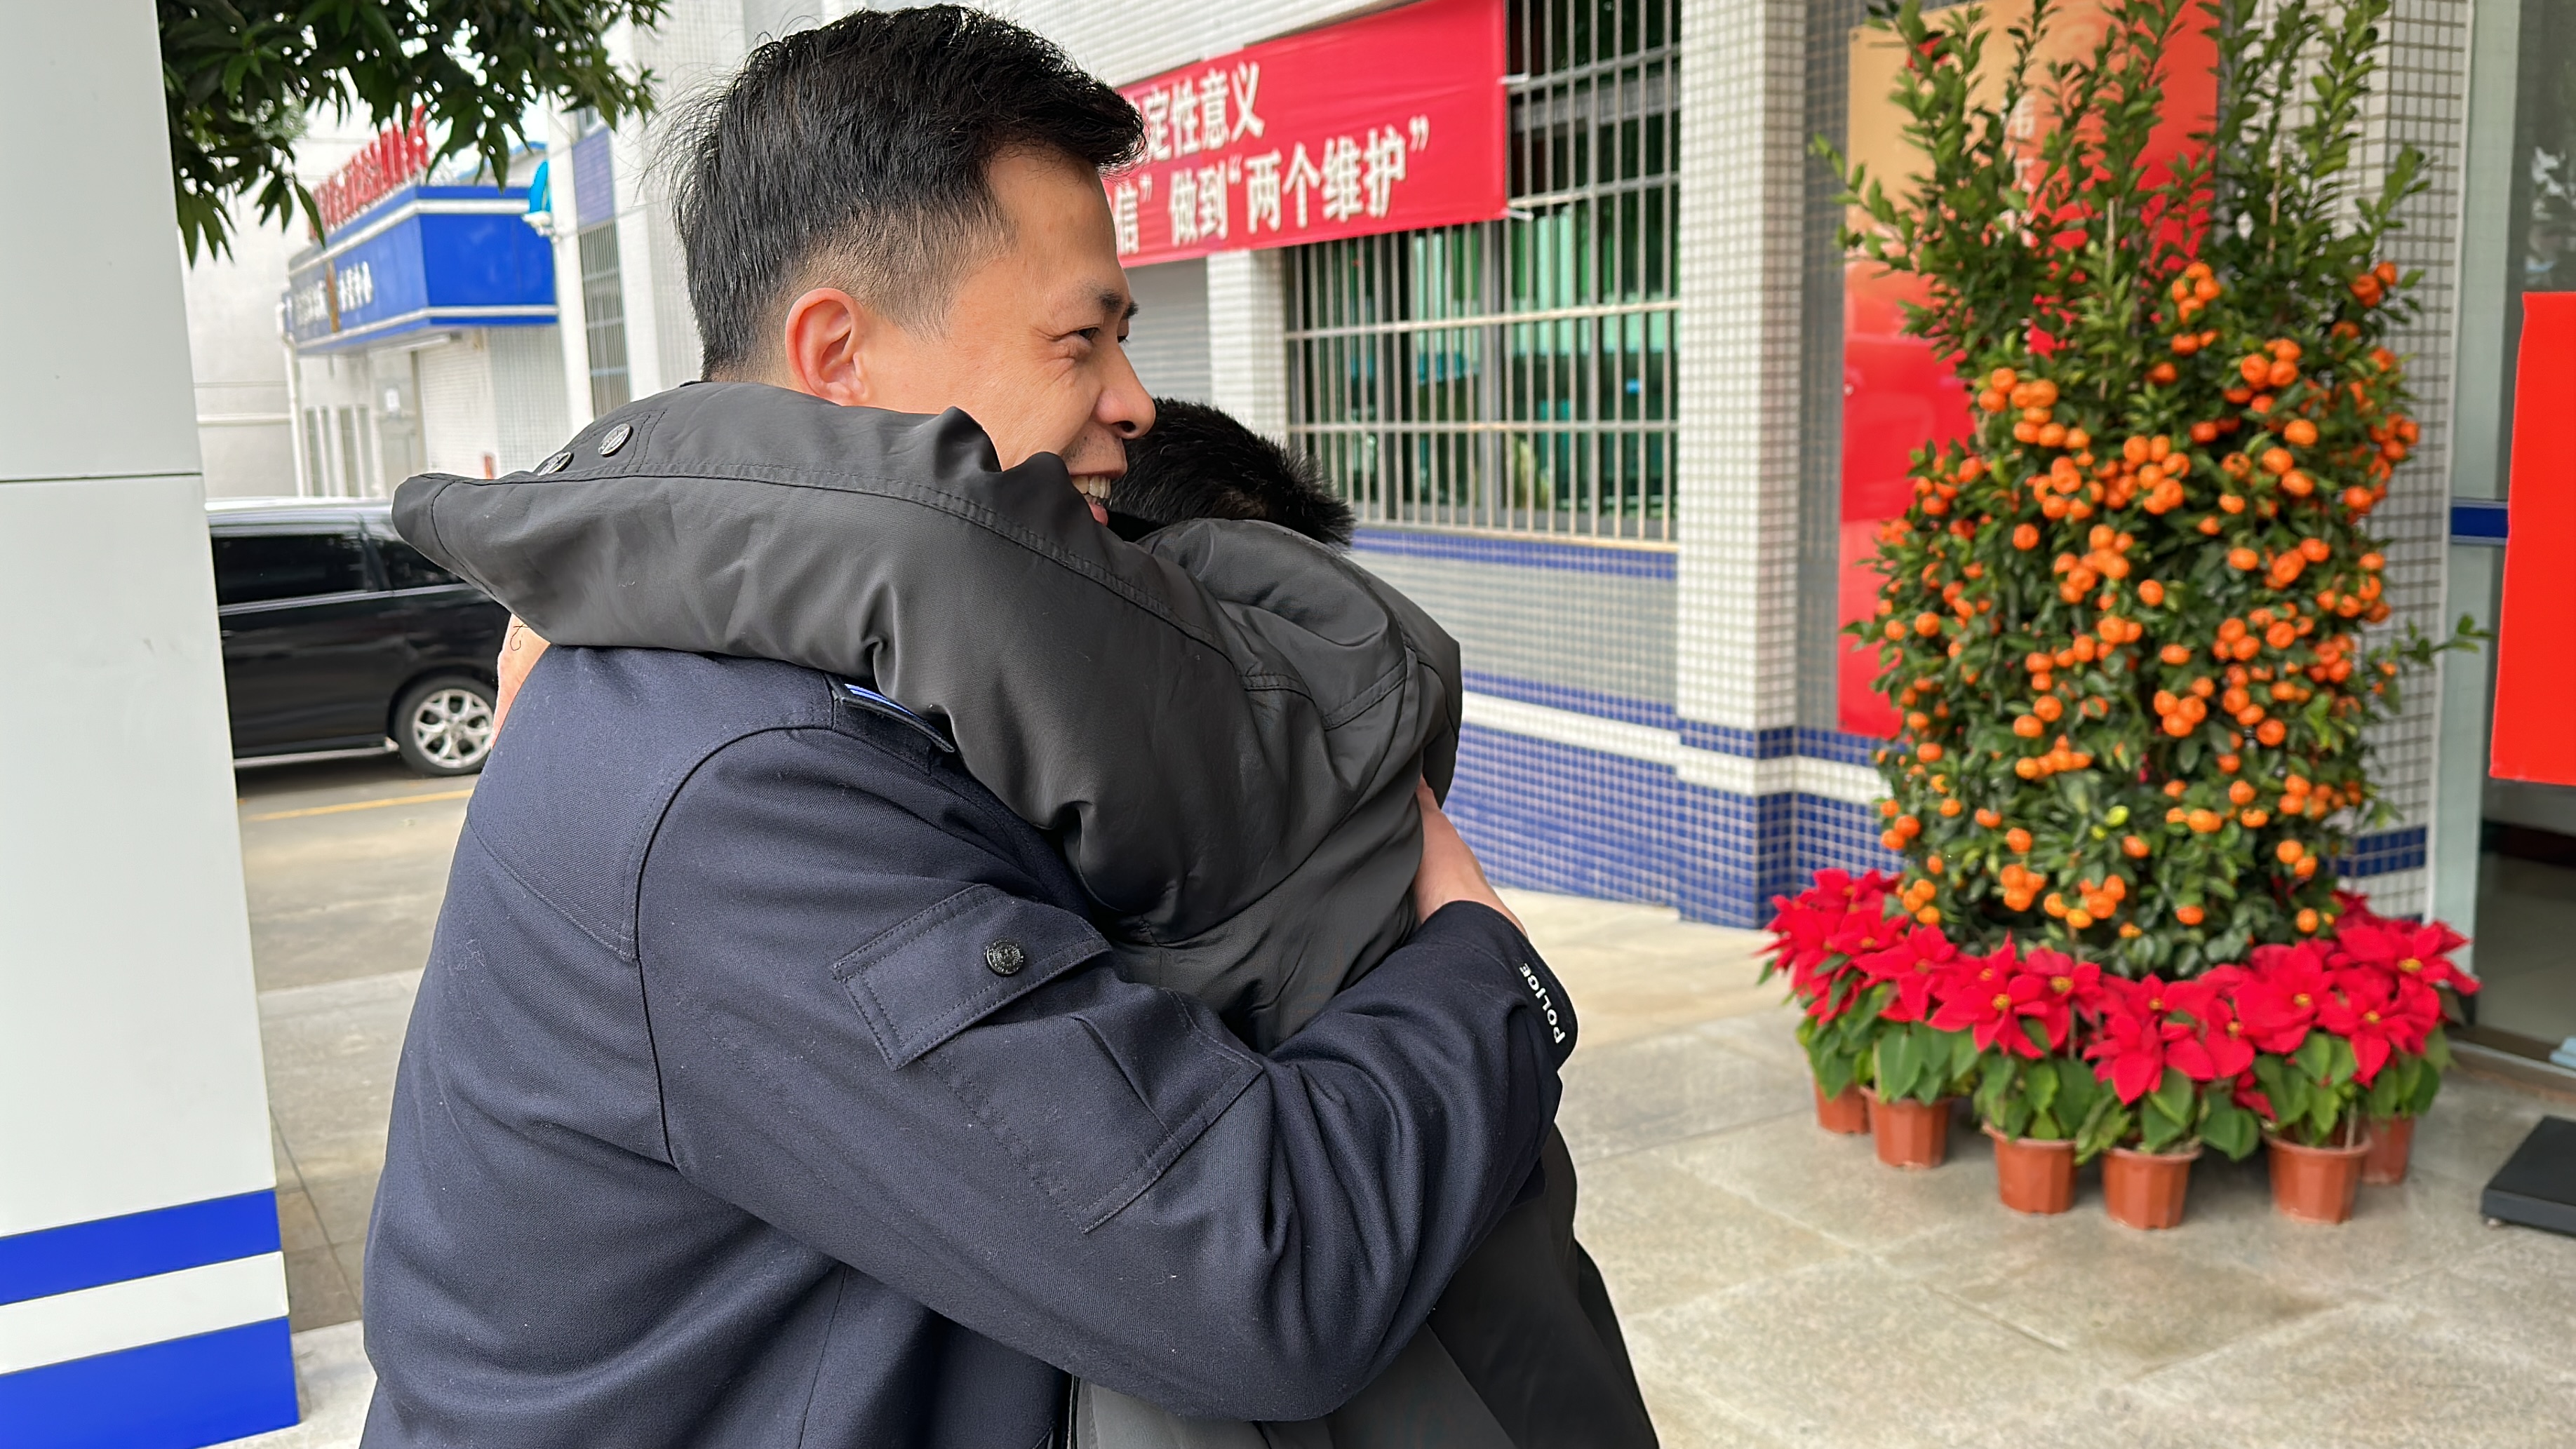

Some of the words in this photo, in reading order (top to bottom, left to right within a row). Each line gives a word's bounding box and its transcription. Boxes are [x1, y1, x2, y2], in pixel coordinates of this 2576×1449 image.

[1131, 62, 1265, 162] 定性意义
[1108, 173, 1152, 255] 信”
[1519, 963, 1566, 1044] POLICE
